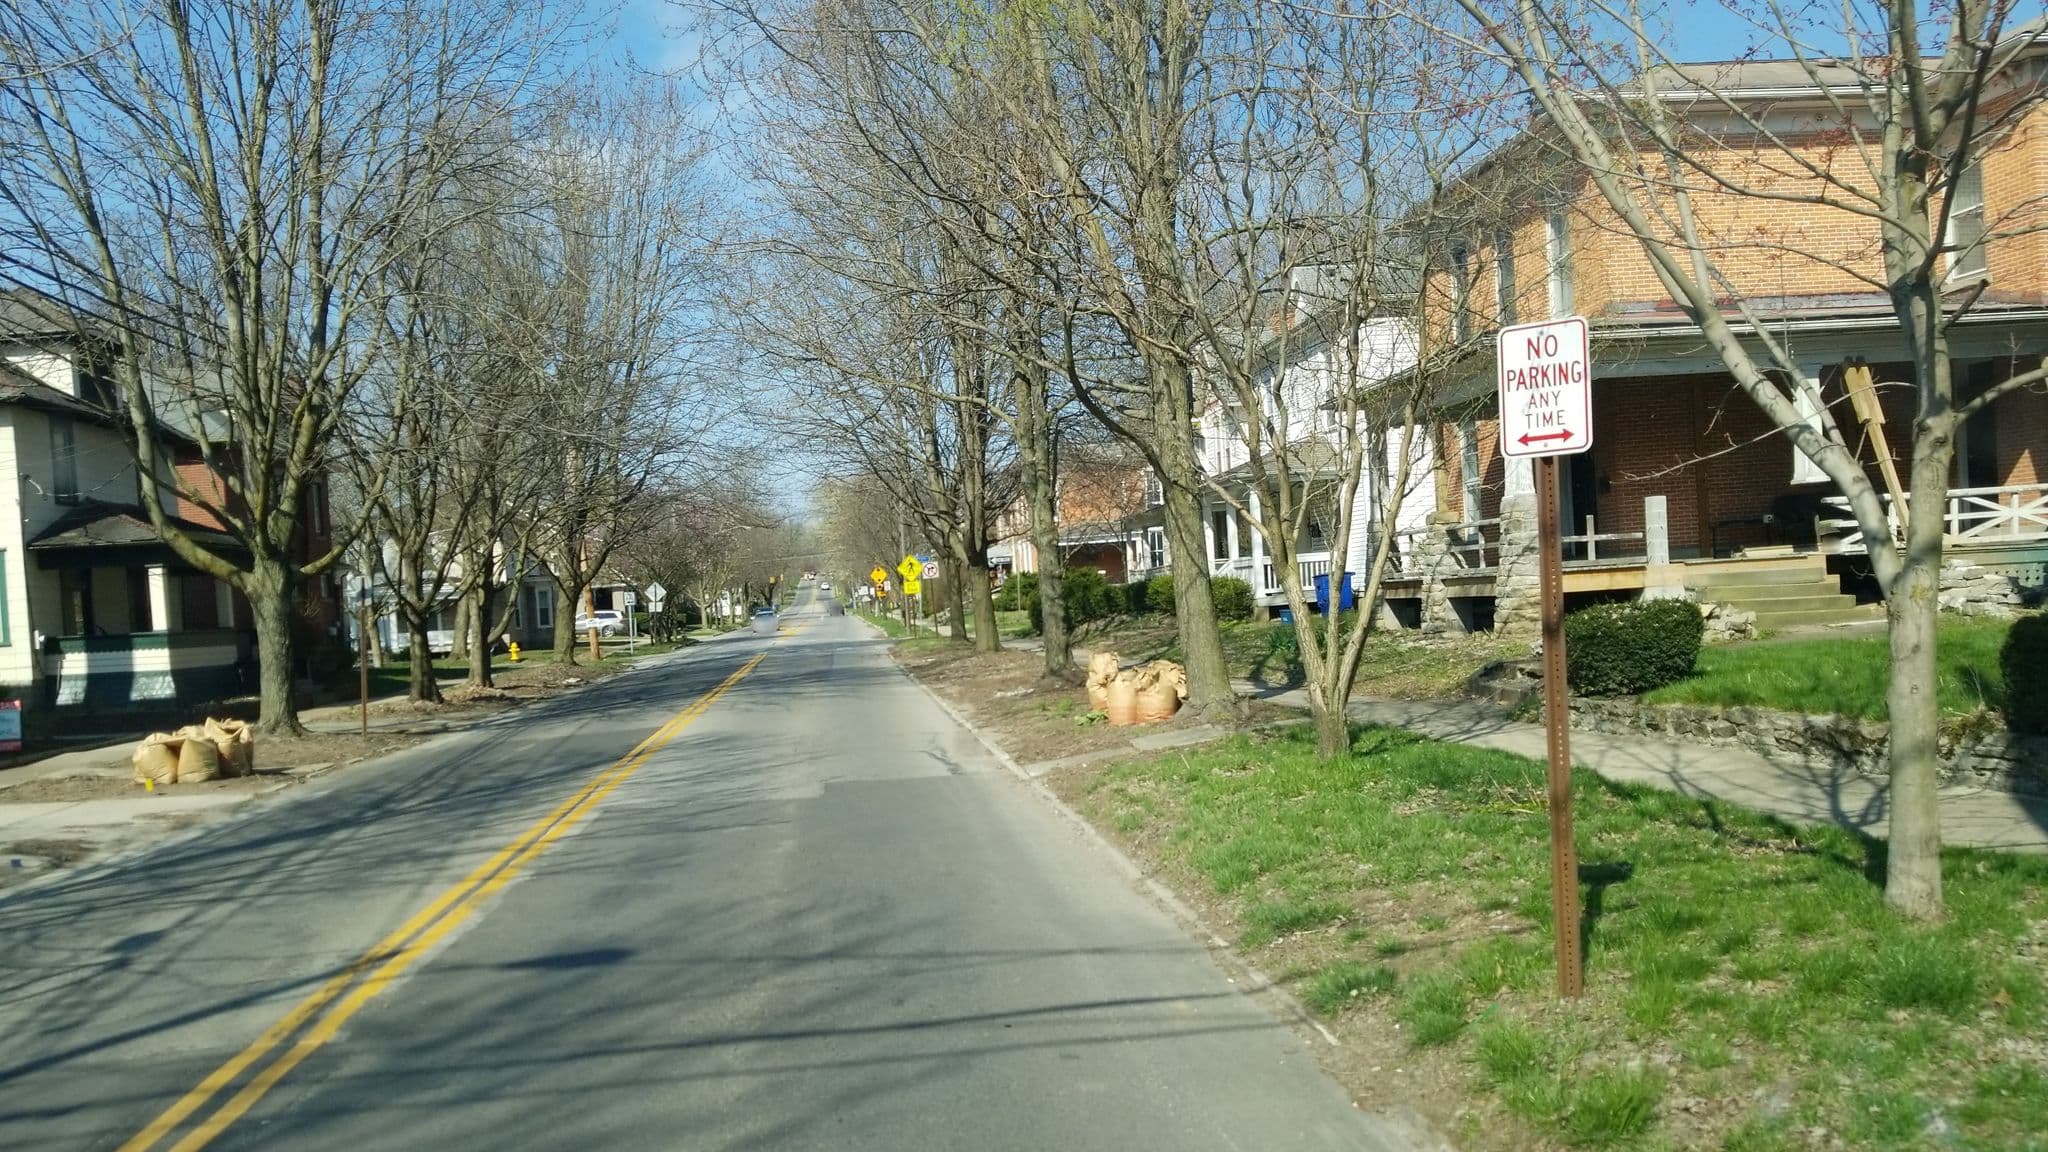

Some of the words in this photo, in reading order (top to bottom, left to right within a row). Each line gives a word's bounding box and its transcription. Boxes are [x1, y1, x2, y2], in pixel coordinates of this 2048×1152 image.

[1527, 334, 1558, 360] NO
[1506, 361, 1582, 392] PARKING
[1528, 390, 1561, 409] ANY
[1525, 410, 1566, 429] TIME
